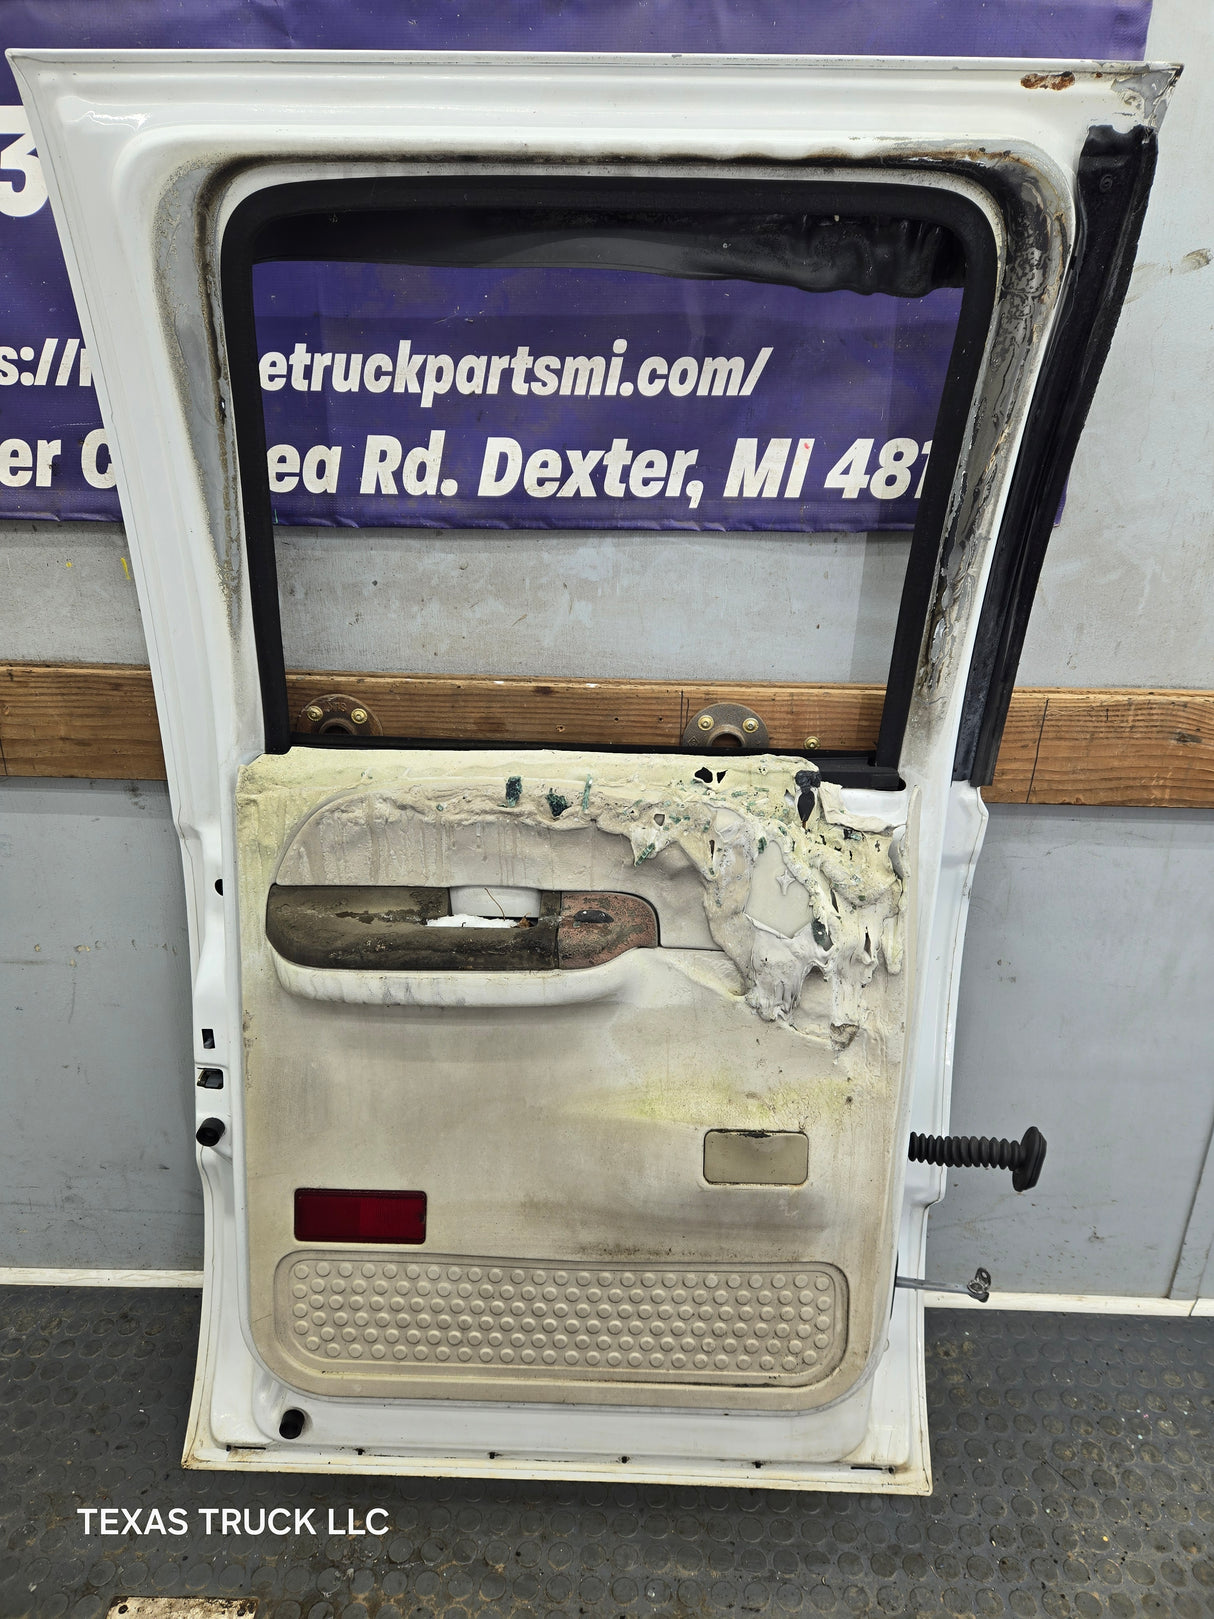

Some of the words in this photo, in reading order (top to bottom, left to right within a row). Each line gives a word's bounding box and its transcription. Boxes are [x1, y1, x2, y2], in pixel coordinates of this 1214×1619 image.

[0, 438, 62, 488] er
[266, 444, 342, 494] ea
[360, 430, 458, 496] Rd.
[477, 436, 704, 509] Dexter,
[723, 437, 815, 498] MI
